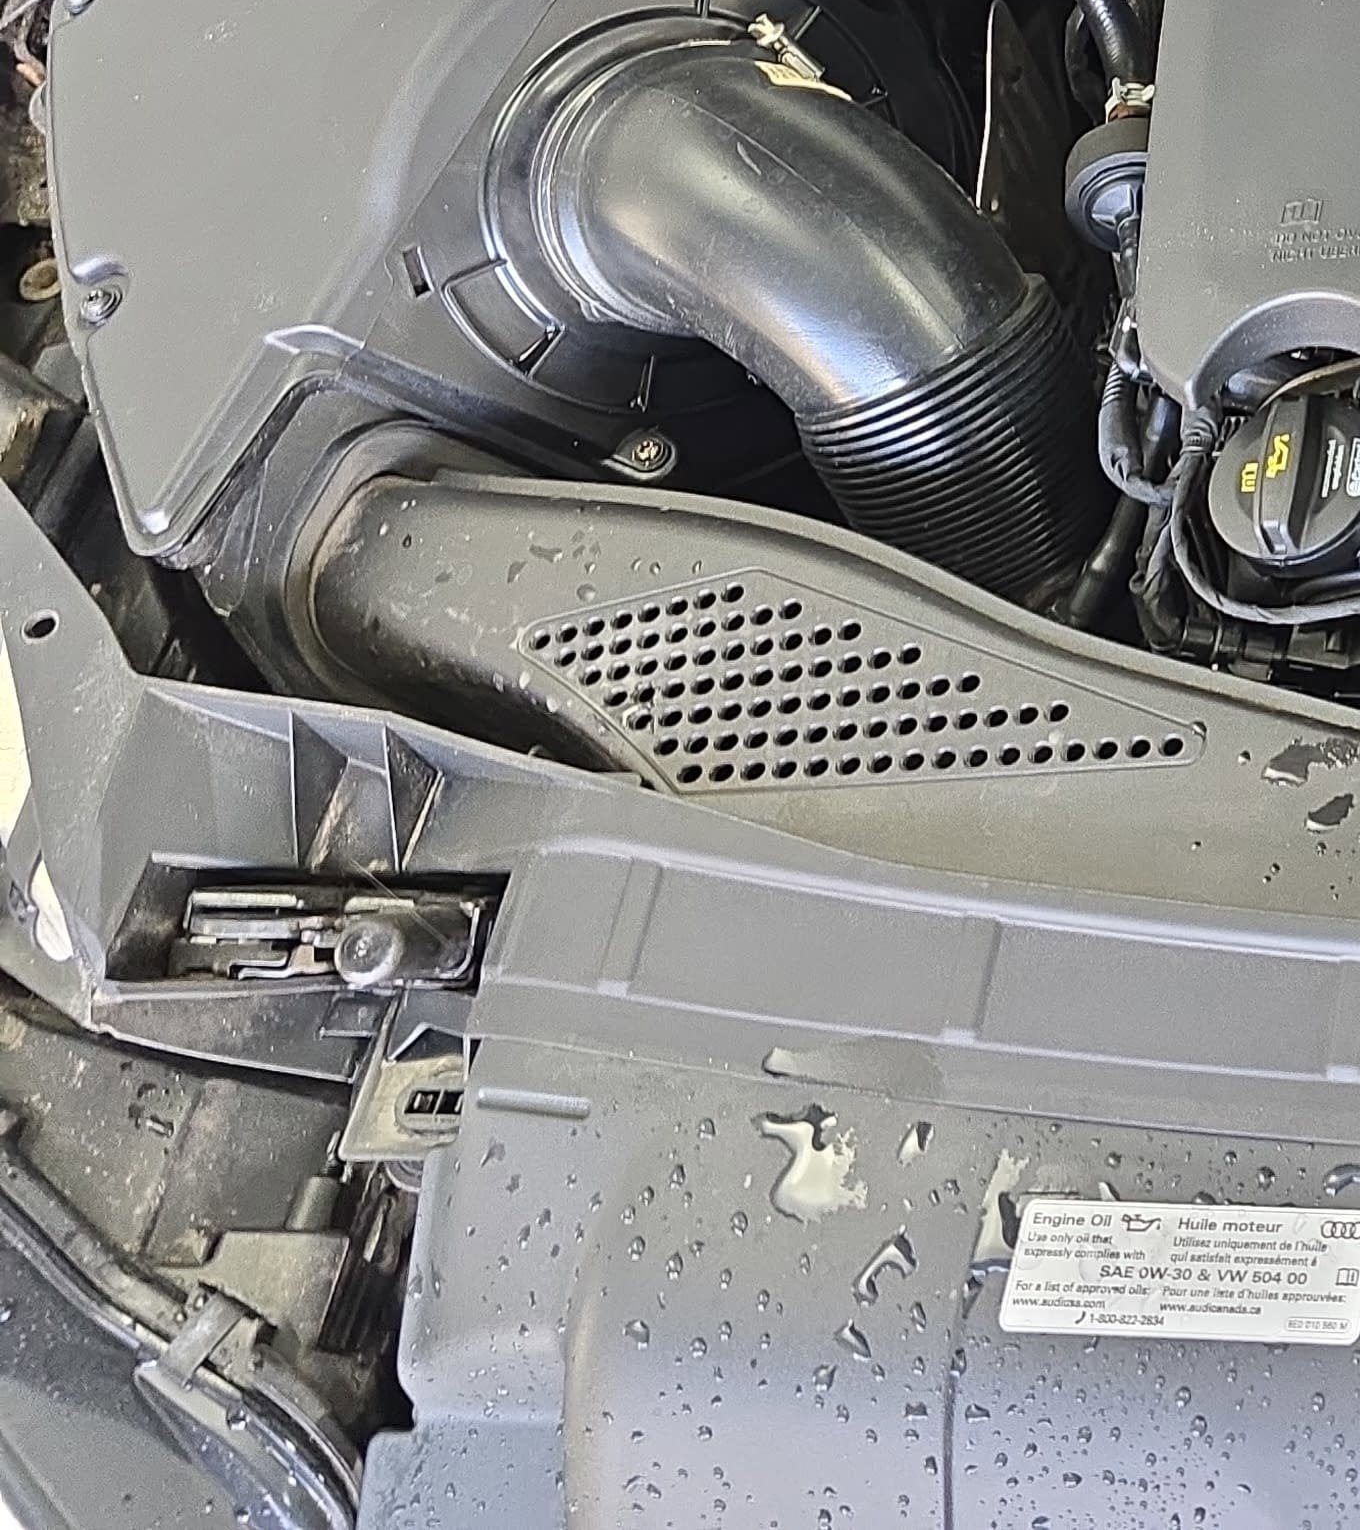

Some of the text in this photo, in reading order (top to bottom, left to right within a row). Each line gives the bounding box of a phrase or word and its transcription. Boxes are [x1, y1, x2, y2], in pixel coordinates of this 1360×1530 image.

[1302, 229, 1331, 242] NOT
[1033, 1212, 1112, 1228] Engine Oil
[1178, 1218, 1283, 1233] Huile moteur
[1028, 1232, 1112, 1245] Use only oil that
[1024, 1247, 1145, 1260] expressly complies with
[1100, 1265, 1308, 1285] SAE 0W-30 & VW 504 00
[1015, 1280, 1033, 1291] For
[1044, 1281, 1060, 1292] list
[1063, 1281, 1074, 1292] of
[1076, 1283, 1126, 1295] approved
[1162, 1286, 1187, 1297] Pour
[1190, 1288, 1209, 1298] une
[1213, 1288, 1235, 1299] liste
[1237, 1288, 1279, 1301] d'huiles
